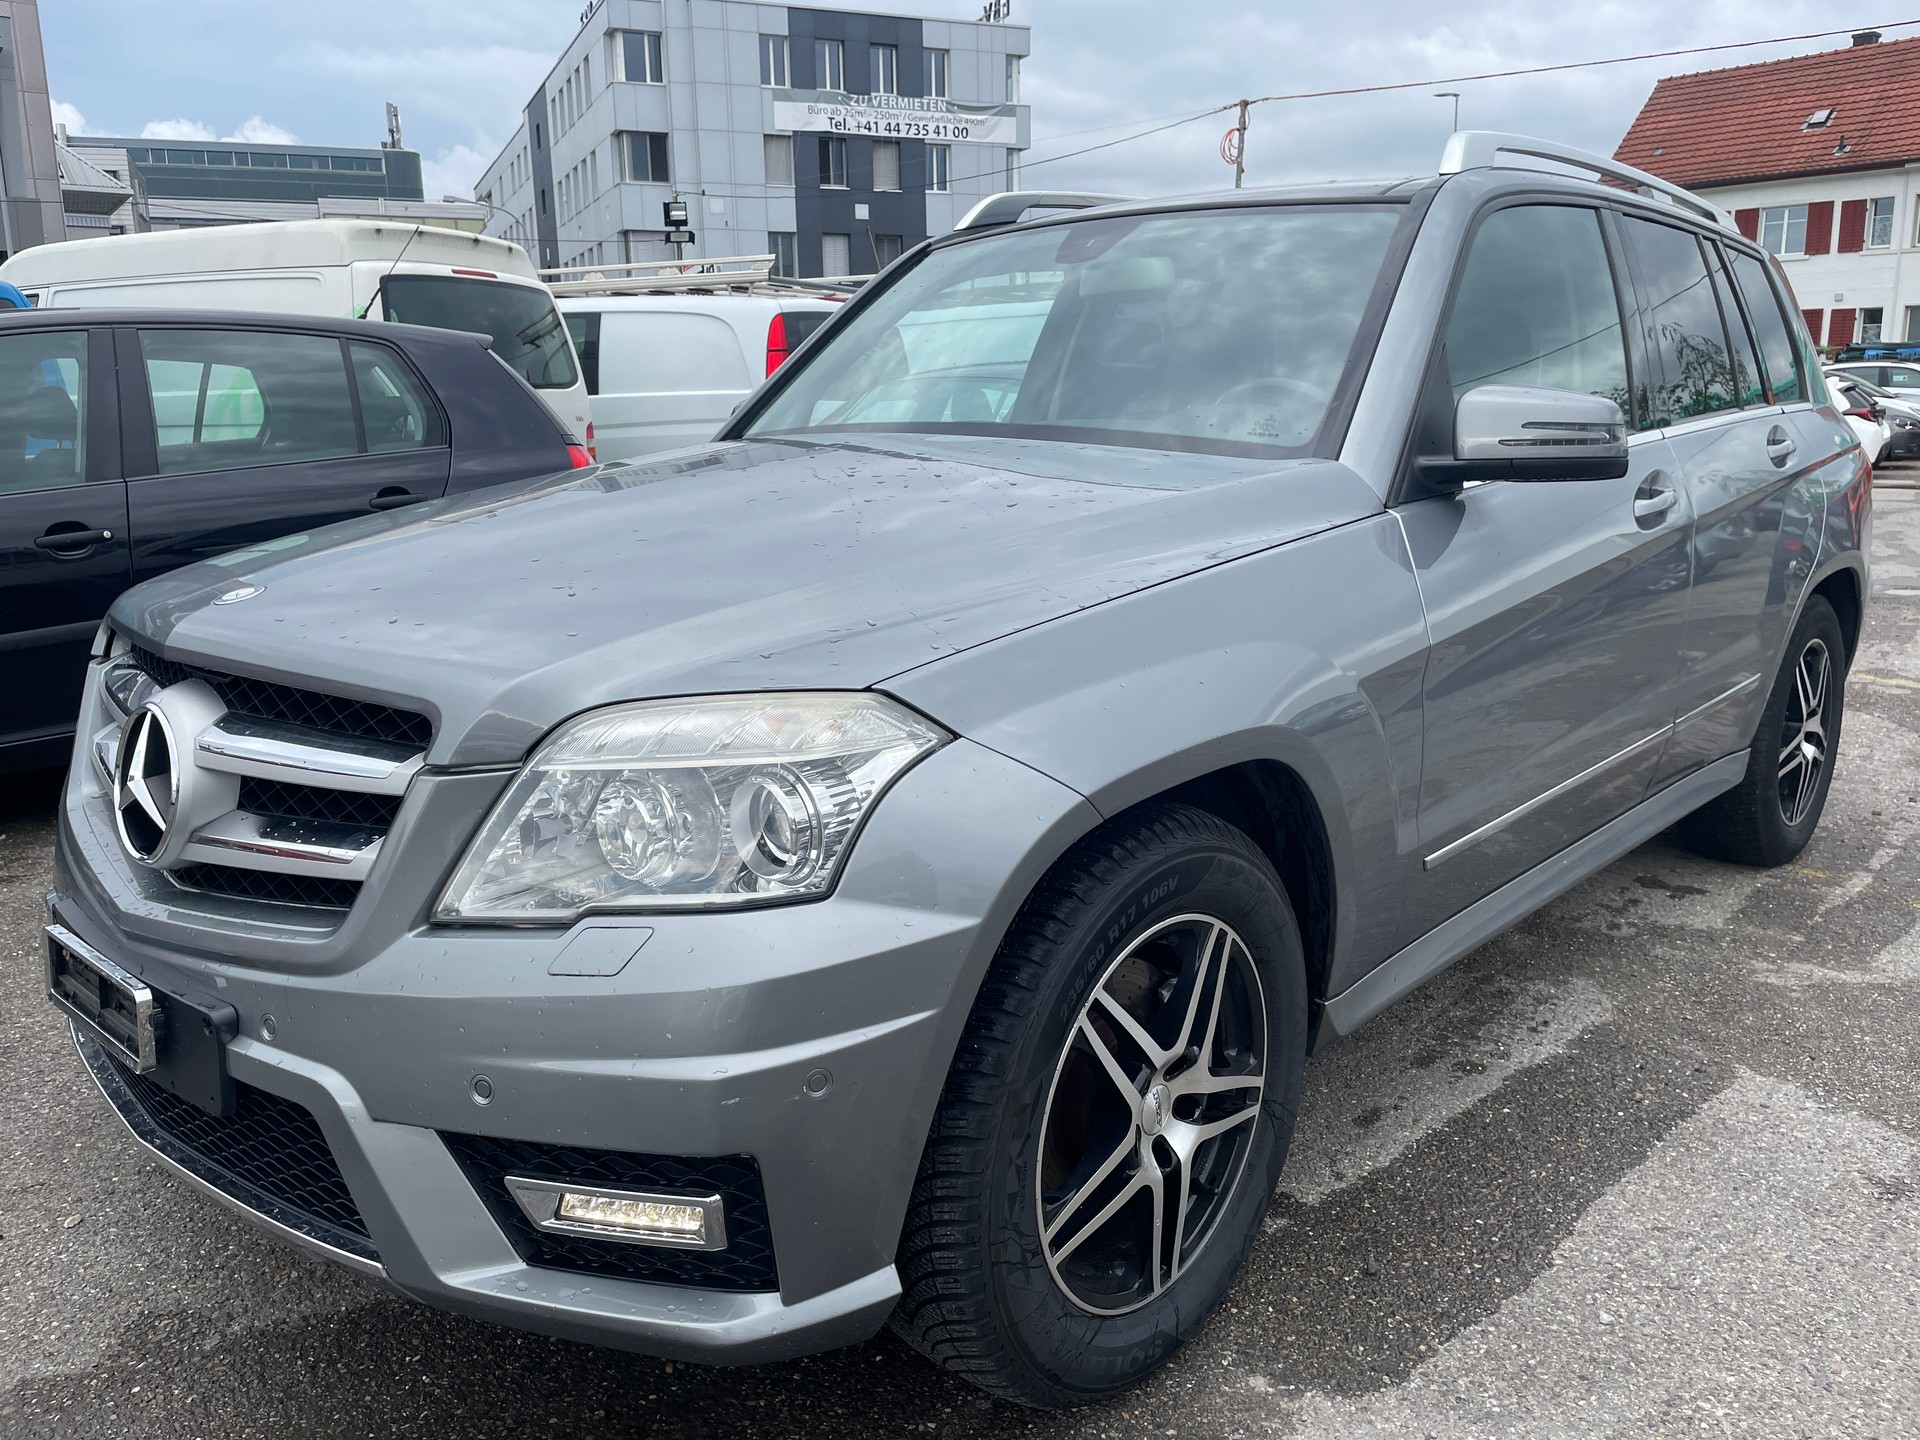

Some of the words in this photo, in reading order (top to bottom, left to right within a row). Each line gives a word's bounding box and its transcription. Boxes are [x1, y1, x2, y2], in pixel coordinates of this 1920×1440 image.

[808, 105, 829, 115] Büro
[830, 106, 842, 117] ab
[850, 94, 868, 107] ZU
[872, 95, 947, 112] VERMIETEN
[827, 116, 851, 131] Tel.
[854, 120, 879, 134] +41
[884, 121, 901, 135] 44
[905, 123, 929, 136] 735
[933, 124, 948, 138] 41
[952, 126, 969, 139] 00
[1060, 942, 1105, 1023] 235/60
[1108, 903, 1137, 944] R17
[1142, 874, 1180, 909] 106V
